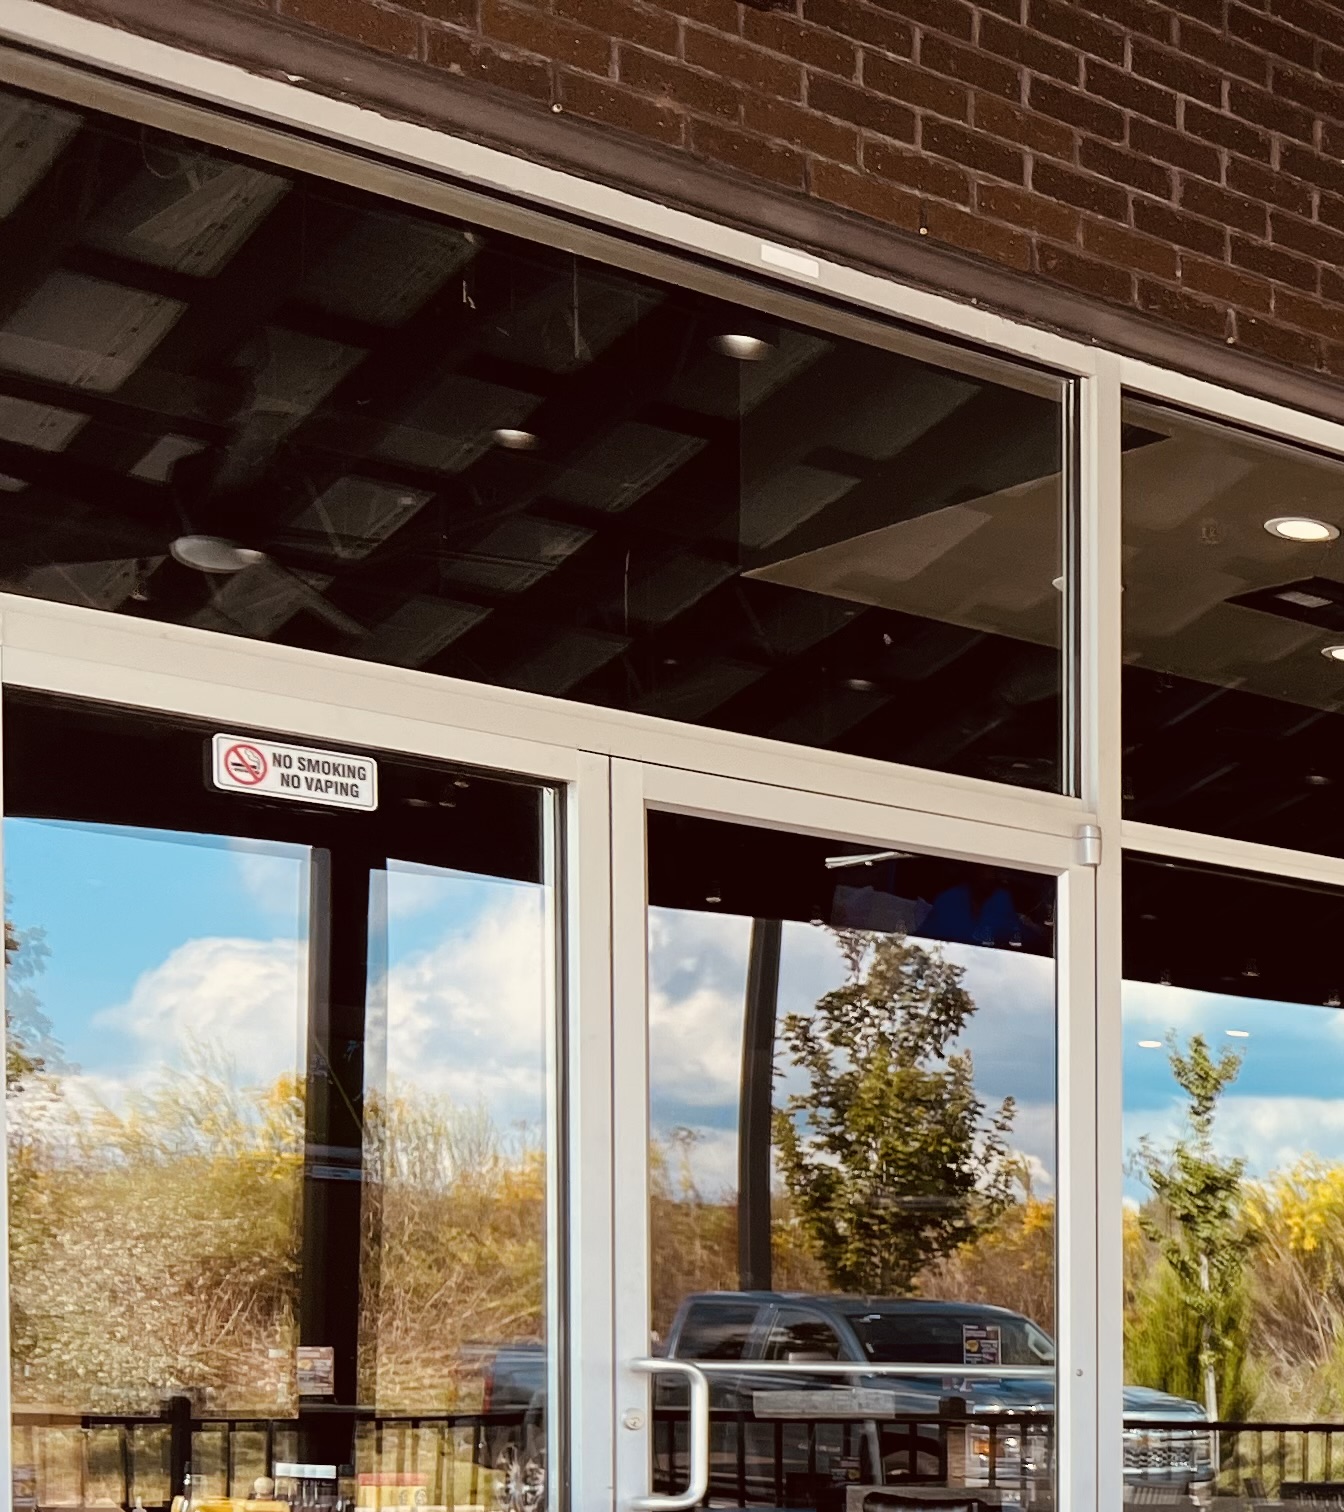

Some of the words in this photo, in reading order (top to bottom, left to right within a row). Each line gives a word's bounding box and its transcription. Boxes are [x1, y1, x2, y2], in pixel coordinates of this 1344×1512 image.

[272, 752, 292, 769] NO
[297, 757, 366, 781] SMOKING
[280, 772, 300, 789] NO
[304, 776, 359, 798] VAPING
